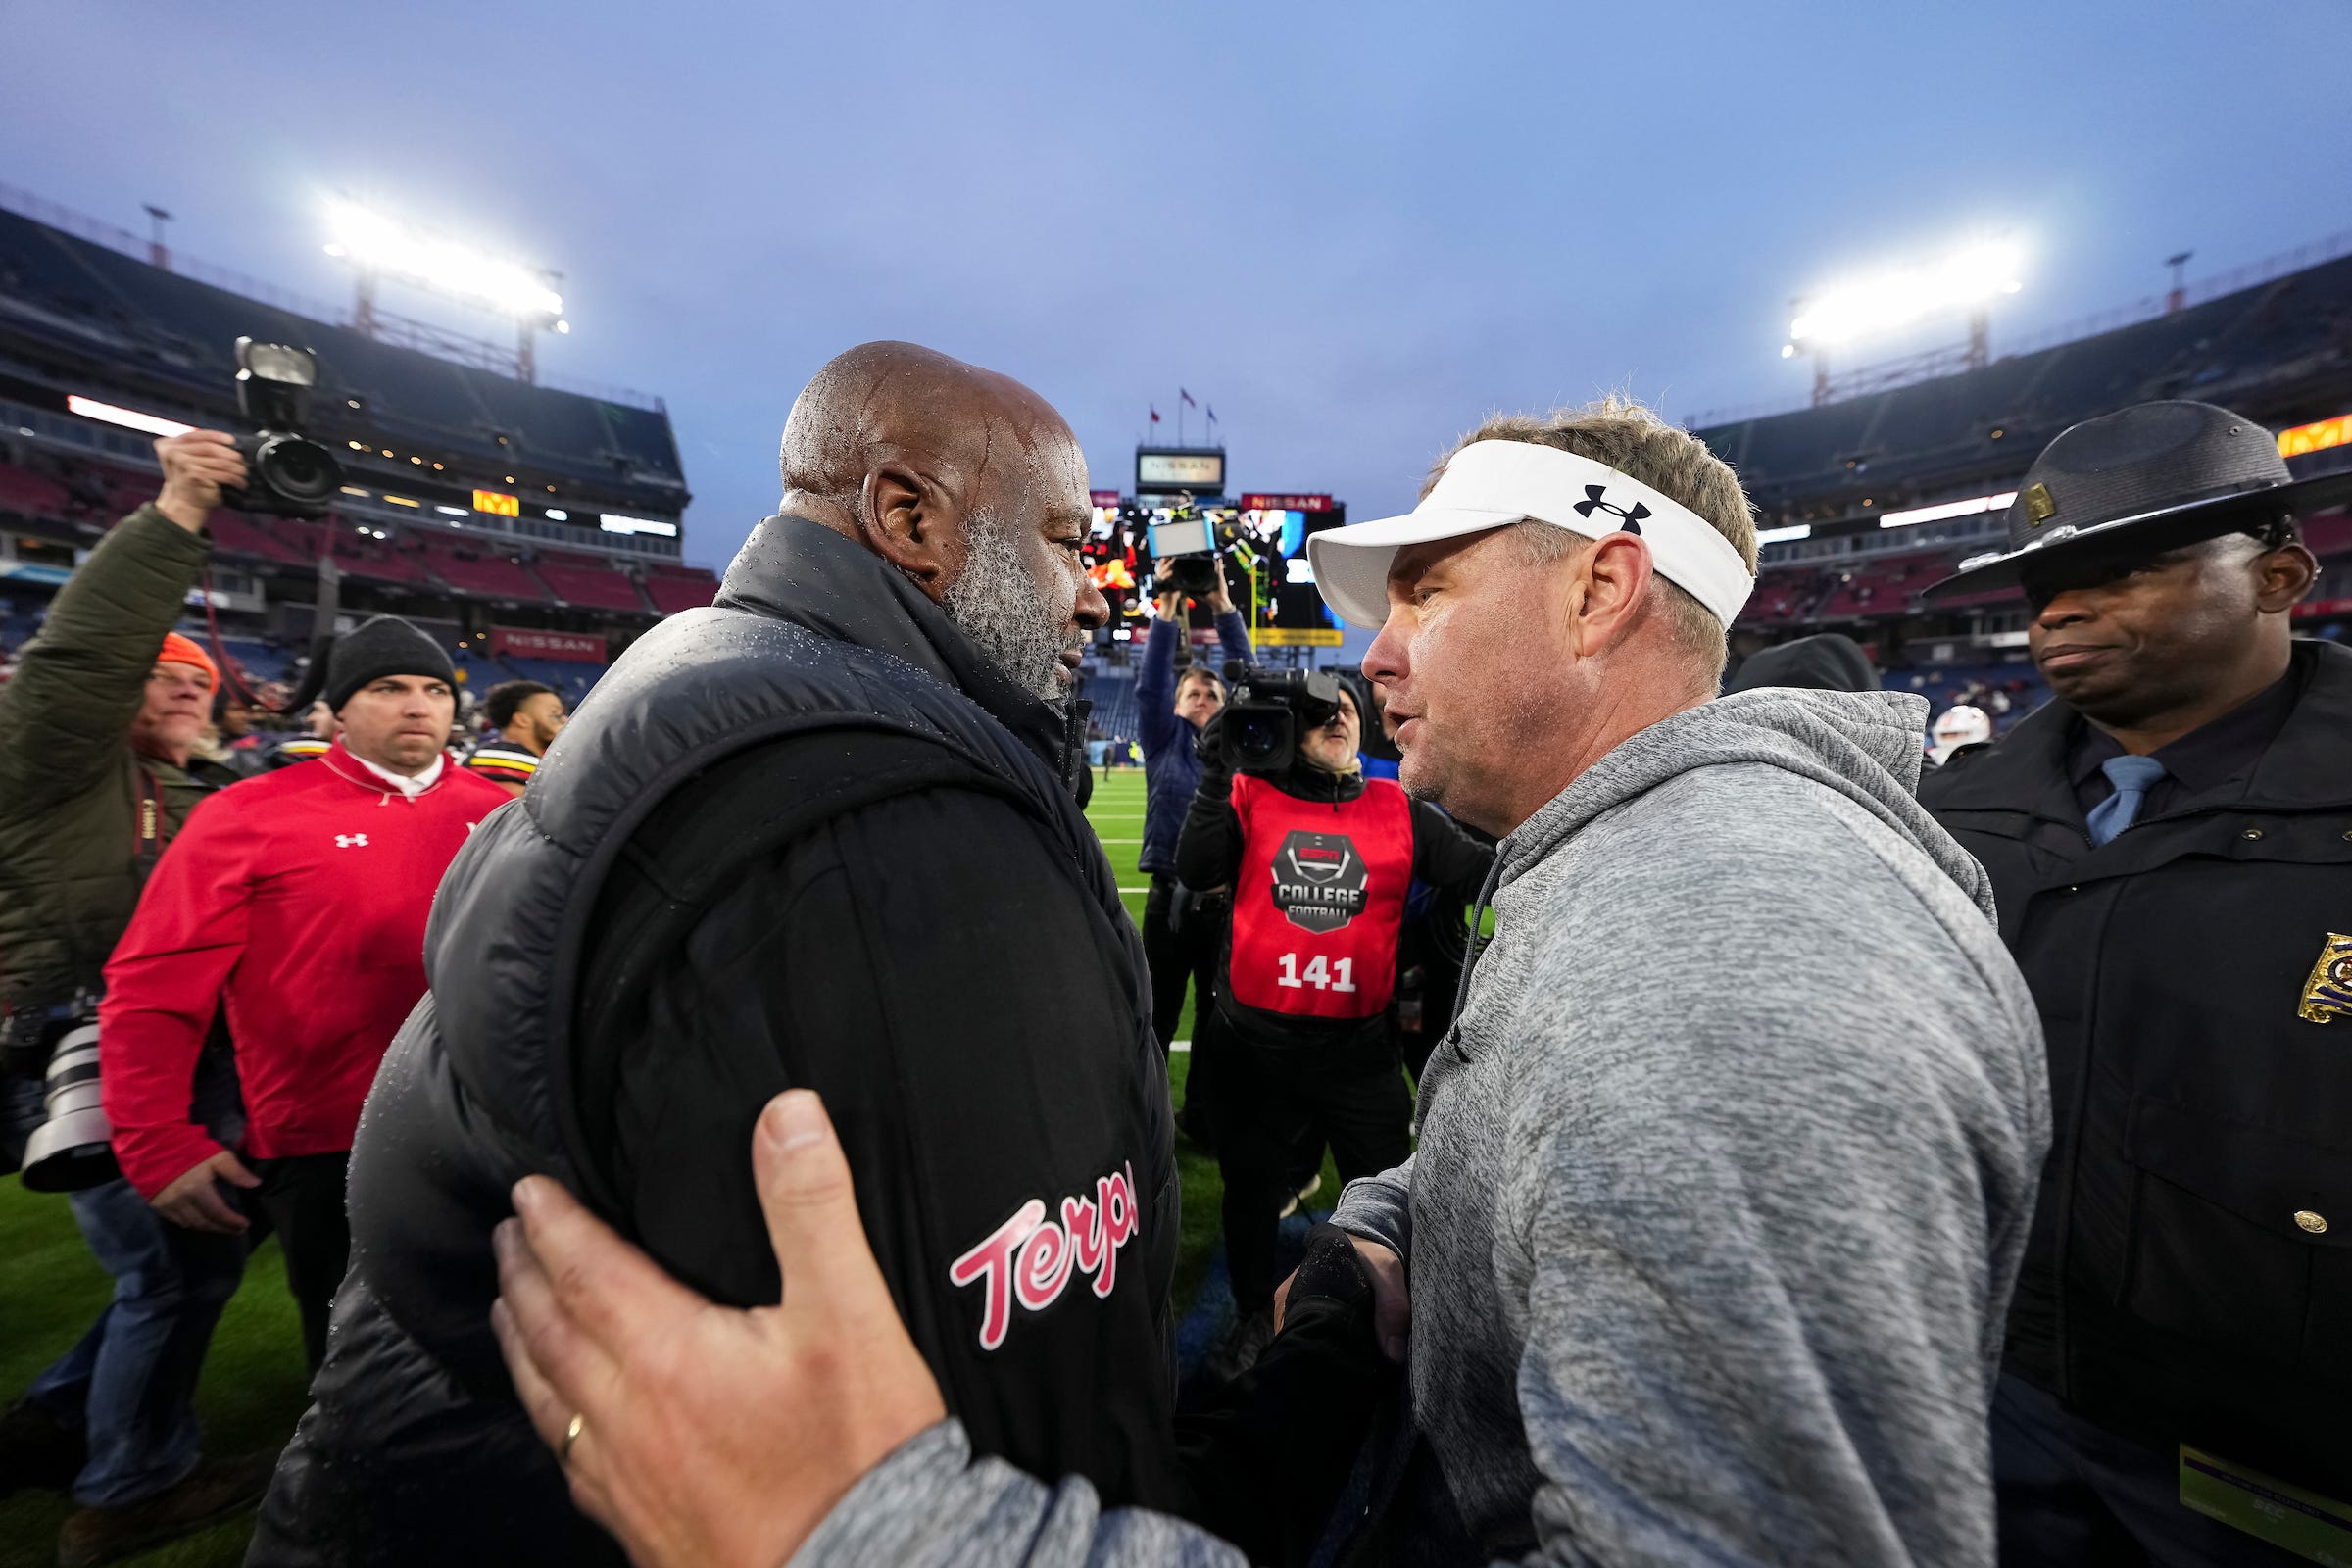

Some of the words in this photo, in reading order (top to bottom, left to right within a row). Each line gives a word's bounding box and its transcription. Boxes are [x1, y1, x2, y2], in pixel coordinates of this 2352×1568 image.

[1251, 496, 1322, 510] NISSAN
[506, 634, 595, 652] NISSAN
[1298, 847, 1339, 860] ESPN
[1278, 884, 1361, 906] COLLEGE
[1288, 905, 1348, 918] FOOTBALL
[1277, 952, 1356, 993] 141
